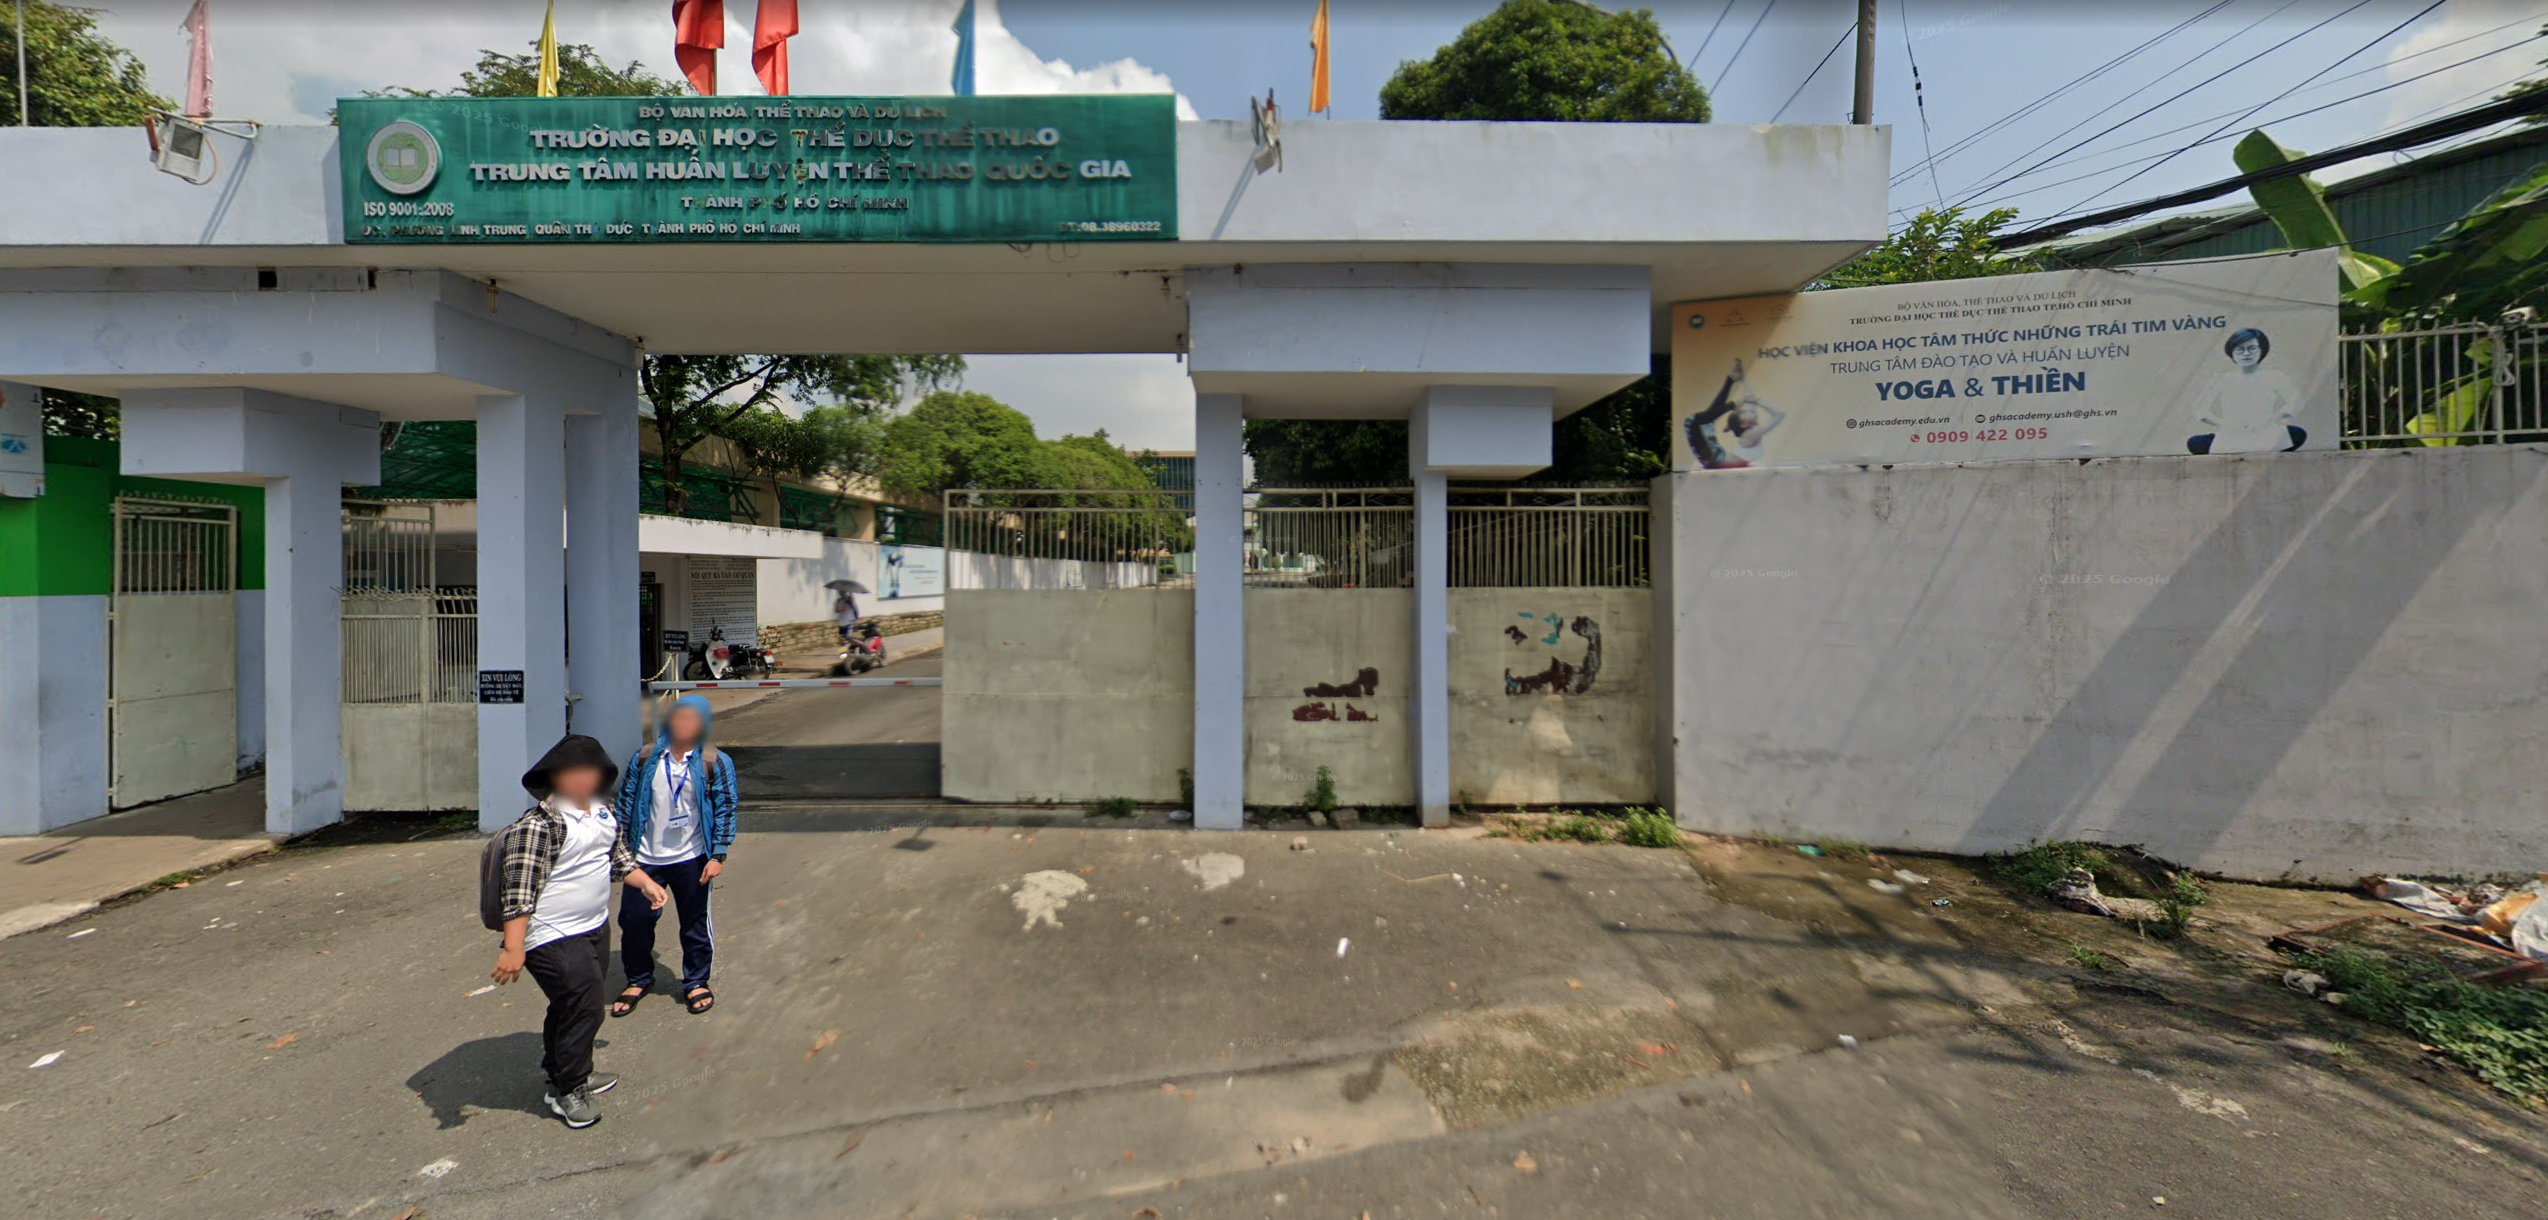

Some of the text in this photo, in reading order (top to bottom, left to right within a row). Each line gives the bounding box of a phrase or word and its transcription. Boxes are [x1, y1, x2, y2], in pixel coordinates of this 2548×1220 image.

[638, 103, 665, 121] BỘ
[755, 99, 791, 118] THỂ
[794, 106, 843, 118] THAO
[848, 103, 869, 118] VÀ
[875, 106, 900, 118] DU
[530, 123, 650, 149] TRƯỜNG
[713, 128, 777, 150] HỌC
[791, 120, 845, 148] THỂ
[980, 127, 1061, 147] THAO
[470, 162, 571, 181] TRUNG
[578, 157, 638, 180] TÂM
[646, 149, 725, 180] HUẤN
[834, 148, 890, 180] THỂ
[896, 161, 974, 180] THAO
[986, 154, 1071, 180] QUỐC
[1079, 159, 1132, 178] GIA
[363, 201, 455, 217] ISO 9001:2008
[827, 194, 858, 209] CHÍ
[863, 197, 908, 209] MINH
[483, 224, 527, 235] TRUNG
[743, 220, 766, 234] CHÍ
[769, 223, 800, 234] MINH
[1986, 295, 2014, 305] THAO
[2016, 293, 2031, 303] VÀ
[2034, 292, 2050, 301] DU
[1894, 312, 1912, 323] ĐẠI
[1914, 311, 1937, 322] HỌC
[1962, 307, 1985, 319] DỤC
[2010, 303, 2041, 314] THAO
[2077, 298, 2098, 309] CHÍ
[2101, 297, 2132, 307] MINH
[1758, 314, 2227, 360] HỌC VIỆN KHOA HỌC TÂM THỨC NHỮNG TRÁI TIM VÀNG
[1830, 342, 2131, 374] TRUNG TÂM ĐÀO TẠO VÀ HUẤN LUYỆN
[1875, 366, 2086, 401] YOGA & THIỀN
[1858, 408, 2118, 429] ghsacademy.edu.vn ghsacademy.ush@ghs.vn
[1926, 427, 2048, 444] 0909 422 095
